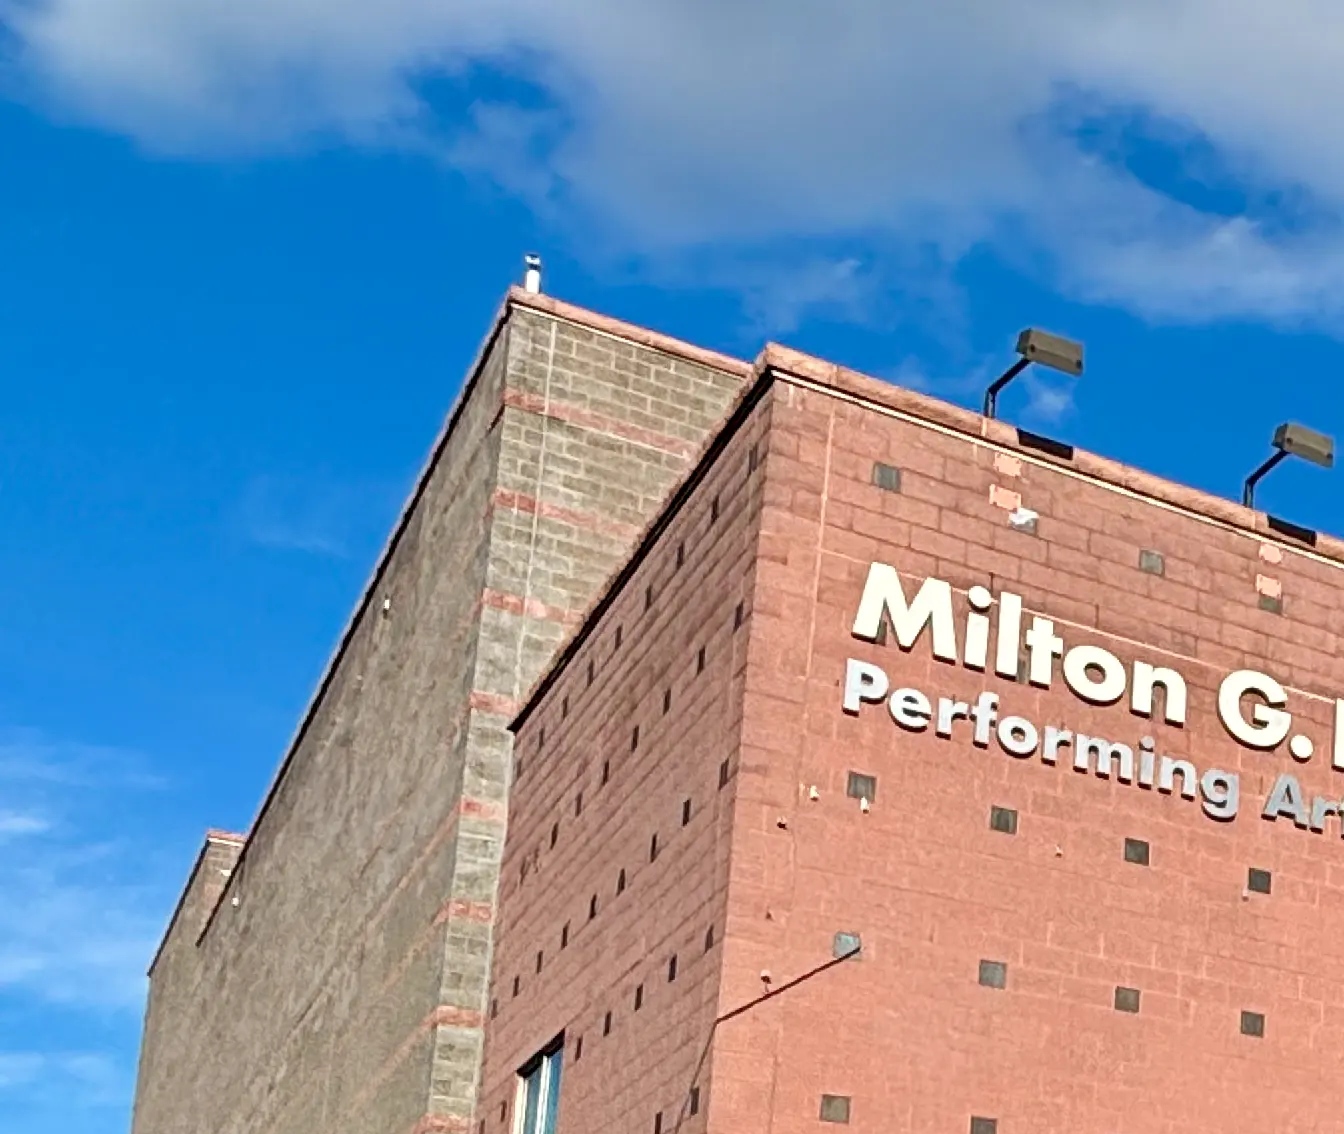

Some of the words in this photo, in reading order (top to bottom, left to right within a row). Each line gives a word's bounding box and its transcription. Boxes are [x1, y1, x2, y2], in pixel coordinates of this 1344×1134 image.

[842, 658, 1240, 821] Performing
[852, 561, 1188, 727] Milton
[1218, 669, 1314, 761] G.
